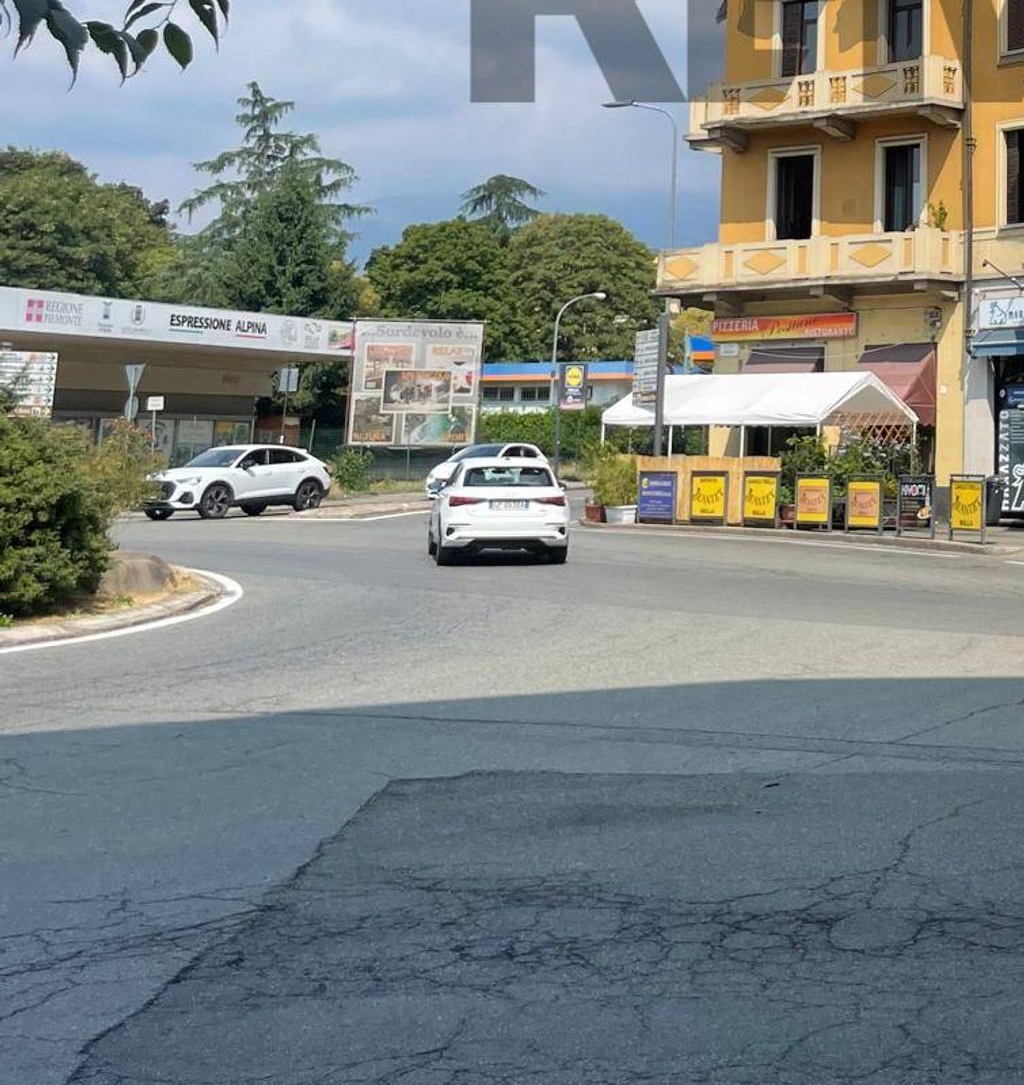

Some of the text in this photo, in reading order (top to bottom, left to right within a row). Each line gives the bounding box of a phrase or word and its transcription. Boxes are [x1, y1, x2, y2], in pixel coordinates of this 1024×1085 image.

[45, 300, 84, 314] REGIONE
[43, 313, 83, 327] PIEMONTE
[169, 314, 268, 335] ESPRESSIONE ALPINA
[713, 318, 759, 332] PIZZERIA
